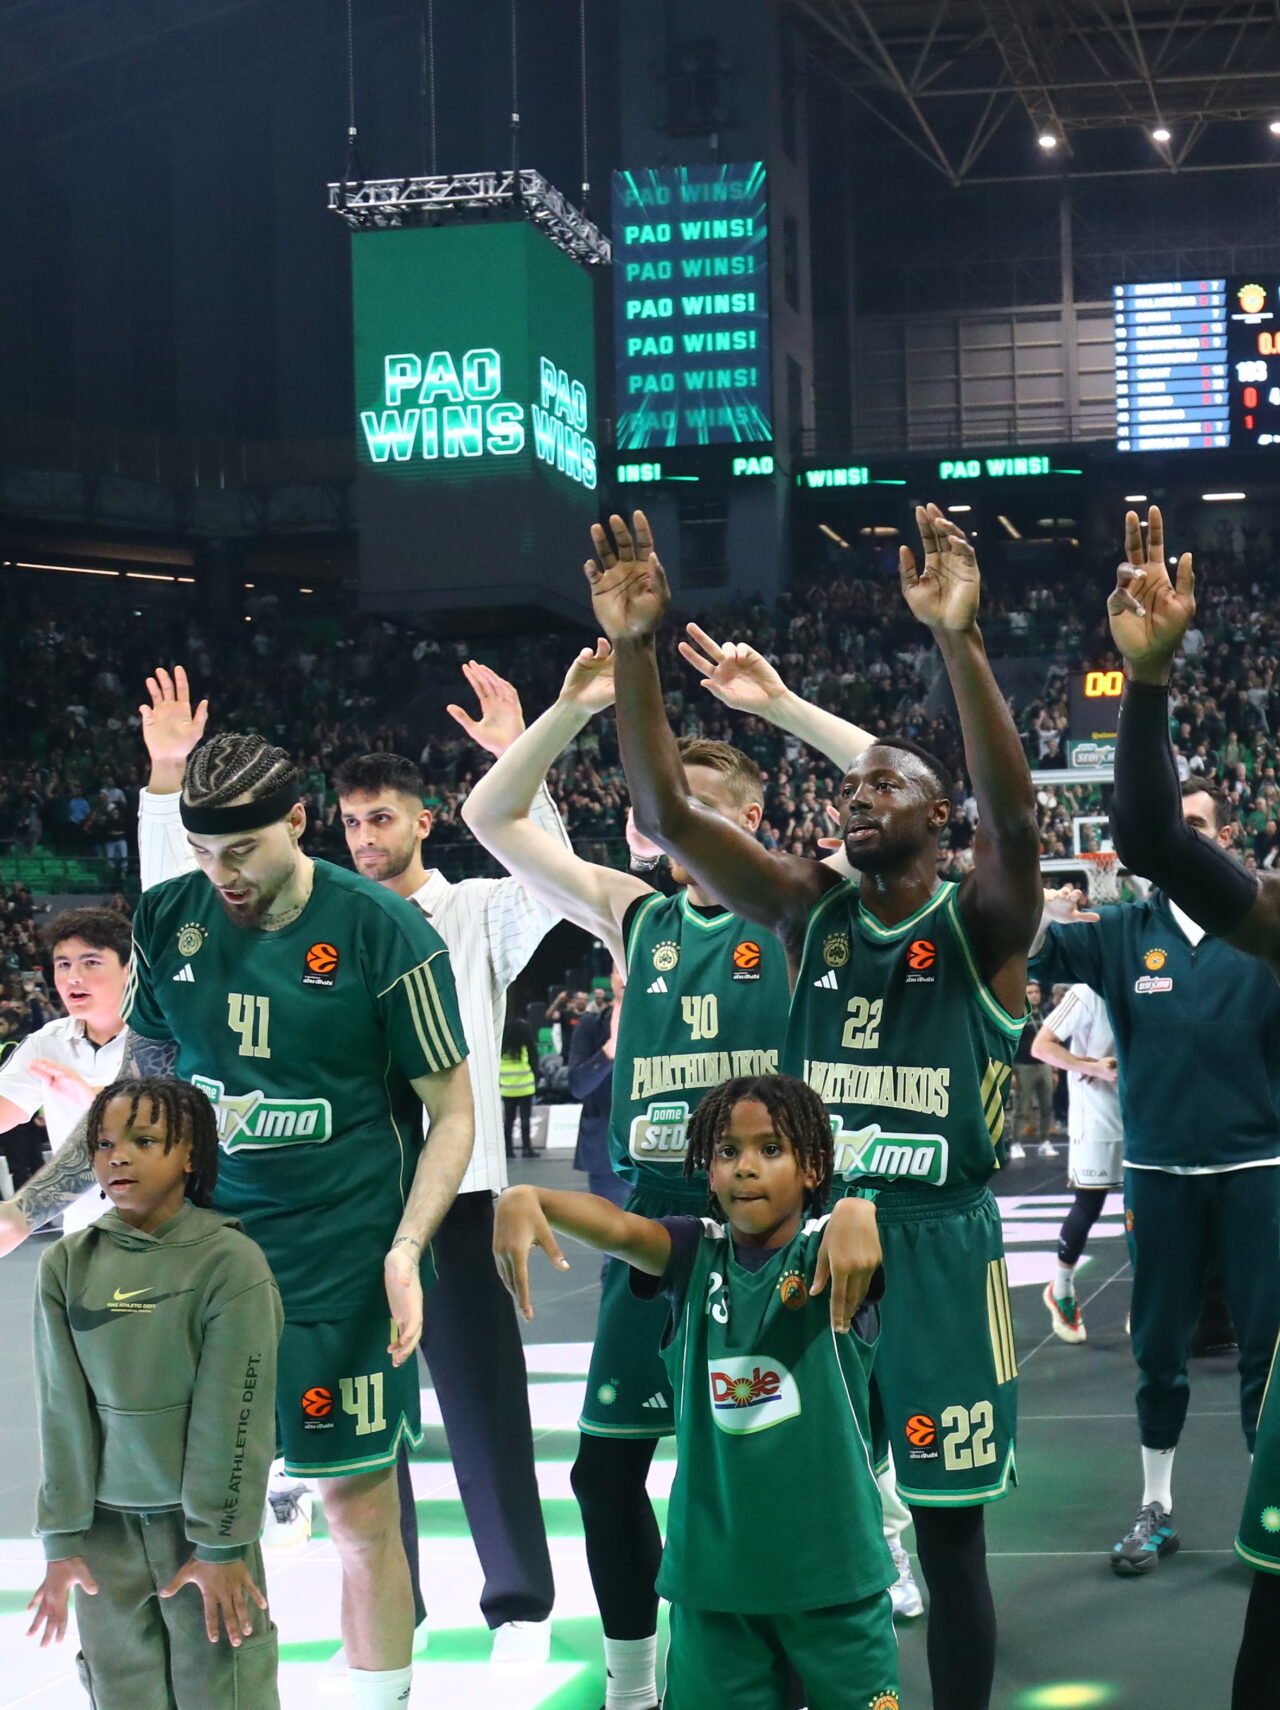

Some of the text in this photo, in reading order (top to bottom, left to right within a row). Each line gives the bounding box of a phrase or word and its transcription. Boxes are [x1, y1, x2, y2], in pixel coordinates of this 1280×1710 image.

[625, 218, 753, 245] PAO WINS!
[626, 255, 755, 282] PAO WINS!
[626, 293, 755, 319] PAO WINS!
[627, 330, 756, 357] PAO WINS!
[384, 348, 501, 406] PAO
[540, 355, 588, 433] PAO
[629, 368, 758, 394] PAO WINS!
[1243, 386, 1257, 408] 0
[360, 402, 525, 463] WINS
[531, 403, 597, 490] WINS
[617, 463, 661, 483] INS!
[733, 456, 774, 476] PAO
[807, 467, 868, 488] WINS!
[939, 456, 1049, 480] PAO WINS!
[227, 993, 271, 1058] 41
[681, 994, 719, 1040] 40
[841, 996, 884, 1049] 22
[630, 1049, 780, 1101] PANATHINAIKOS
[652, 1107, 683, 1123] pame
[710, 1367, 781, 1403] Dole
[339, 1372, 387, 1436] 41
[218, 1352, 262, 1537] NIKE ATHLETIC DEPT.
[940, 1400, 997, 1471] 22
